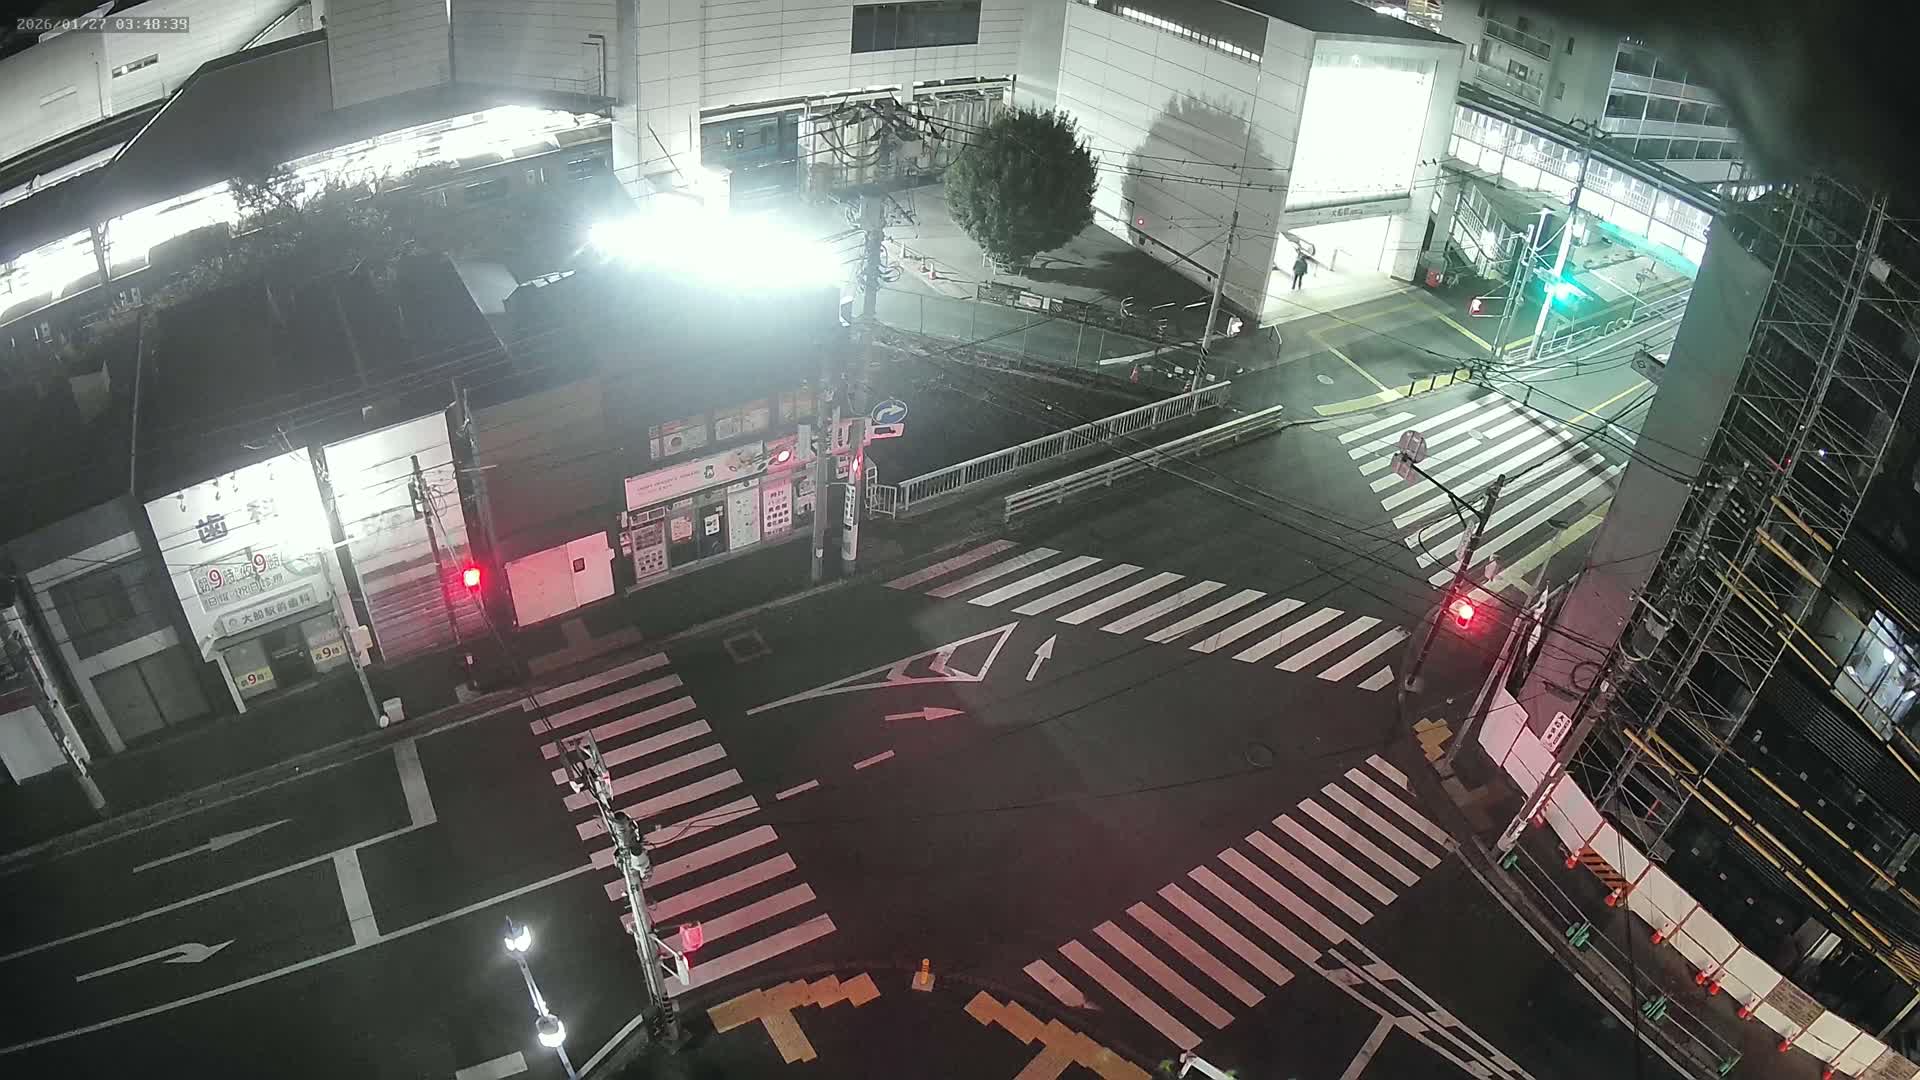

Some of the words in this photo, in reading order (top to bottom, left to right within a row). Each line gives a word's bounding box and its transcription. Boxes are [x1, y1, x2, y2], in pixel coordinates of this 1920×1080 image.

[242, 593, 310, 625] 大船駅前歯科
